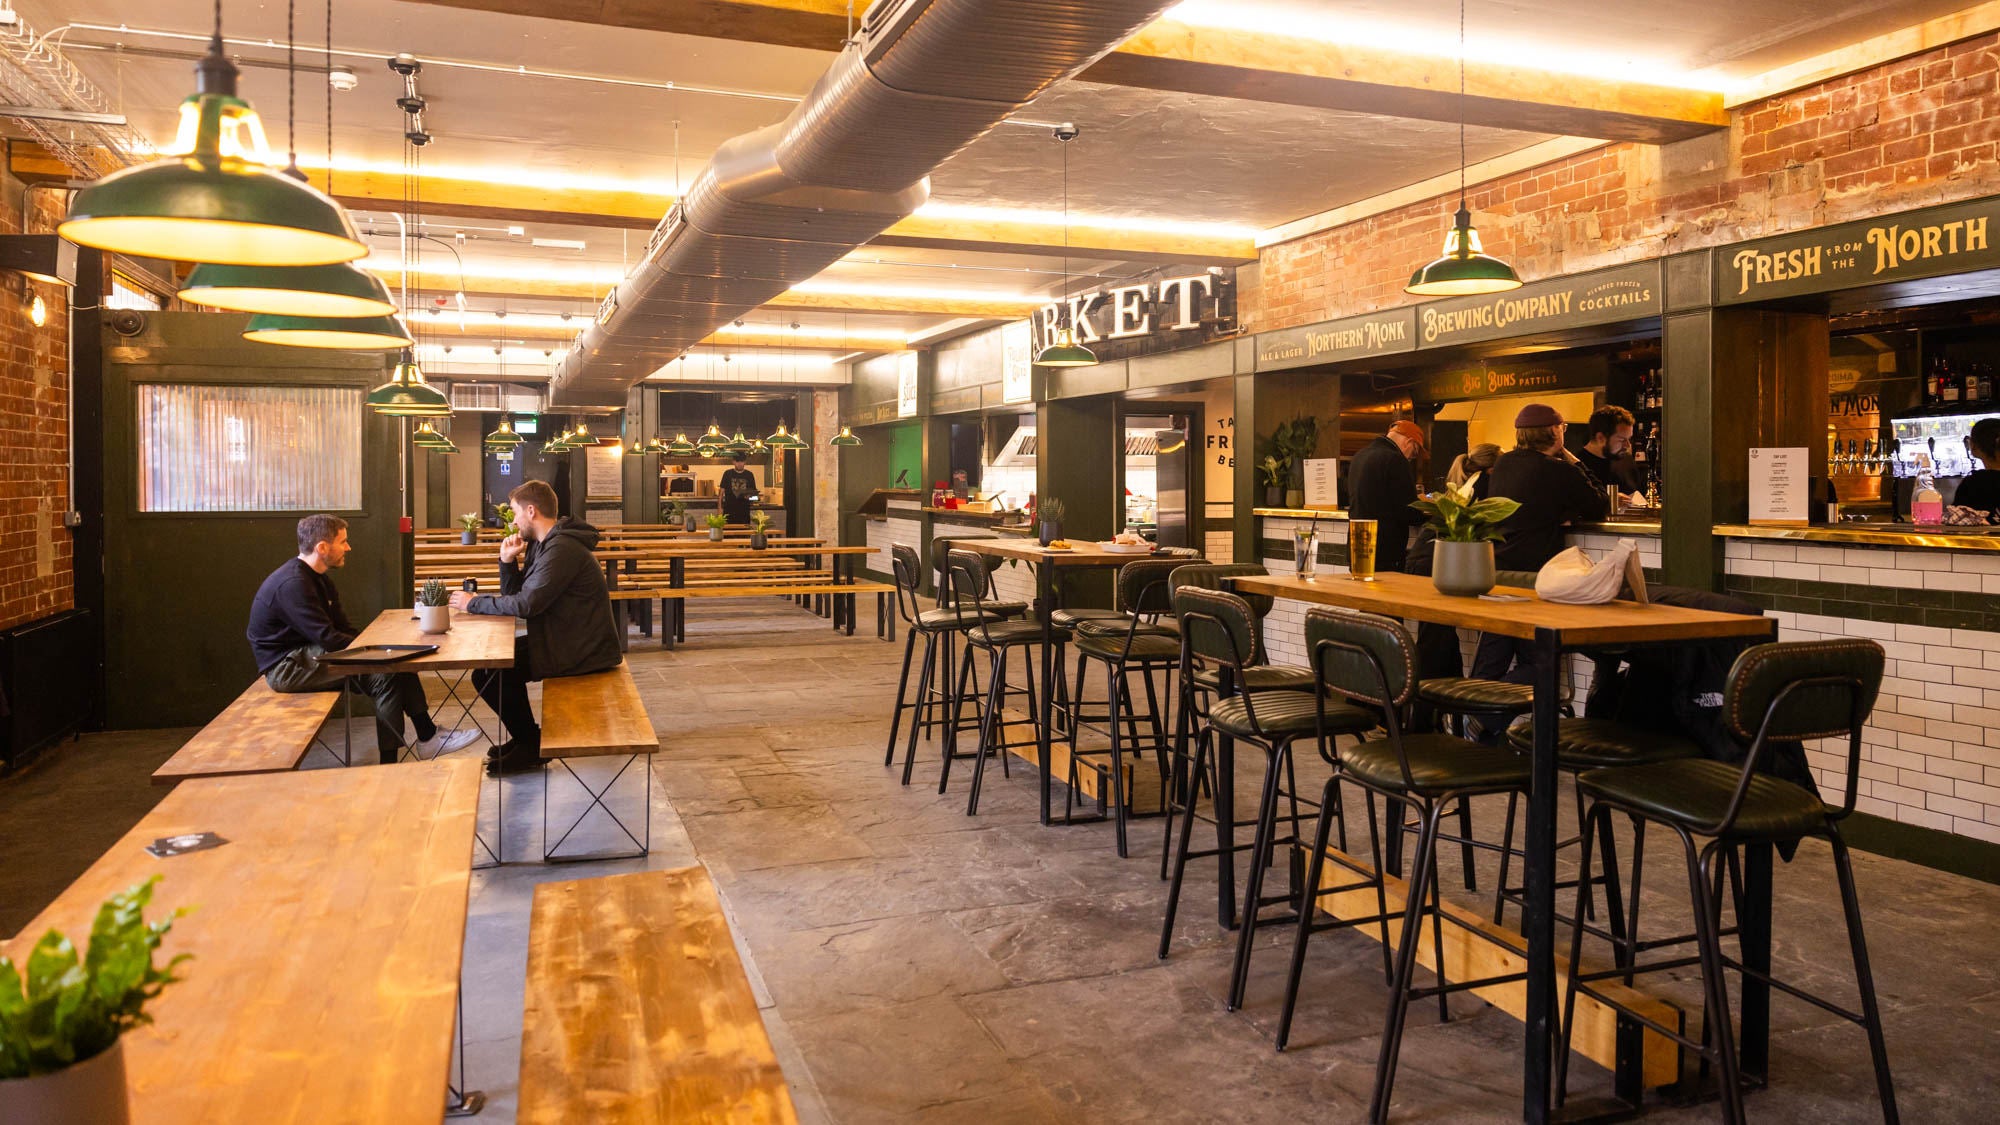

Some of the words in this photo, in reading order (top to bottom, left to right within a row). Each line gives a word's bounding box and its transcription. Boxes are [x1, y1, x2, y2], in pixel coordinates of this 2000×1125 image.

[1826, 242, 1862, 257] FROM
[1867, 216, 1988, 275] NORTH
[1733, 246, 1822, 295] FRESH
[1832, 258, 1855, 270] THE
[1579, 289, 1650, 311] COCKTAILS
[1423, 306, 1493, 342] BREWING
[1494, 290, 1573, 328] COMPANY
[1306, 328, 1364, 358] NORTHERN
[1365, 321, 1406, 349] MONK
[1260, 352, 1272, 361] ALE
[1281, 347, 1303, 359] LAGER
[1463, 373, 1480, 394] BIG
[1488, 371, 1516, 392] BUNS
[1520, 375, 1557, 386] PATTIES
[1207, 435, 1234, 448] FR
